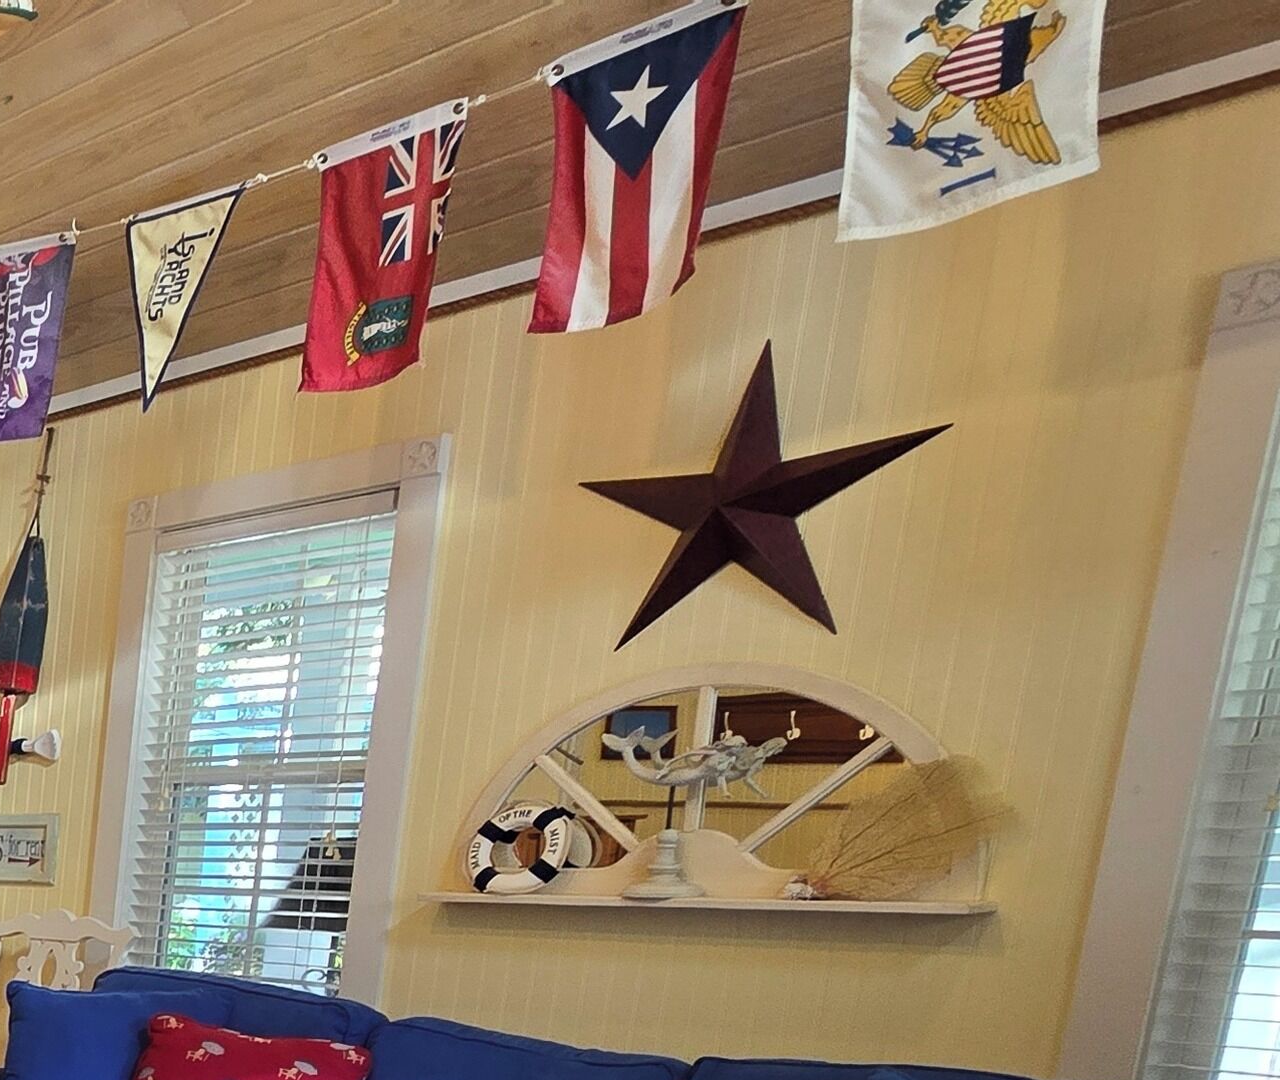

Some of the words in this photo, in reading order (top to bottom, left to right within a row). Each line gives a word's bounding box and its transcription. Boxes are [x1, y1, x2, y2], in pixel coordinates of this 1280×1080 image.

[1, 268, 32, 380] PILLAGE
[17, 290, 52, 370] PUB
[470, 841, 481, 870] MAID
[498, 813, 511, 823] OF
[513, 809, 533, 818] THE
[548, 828, 560, 855] MIST
